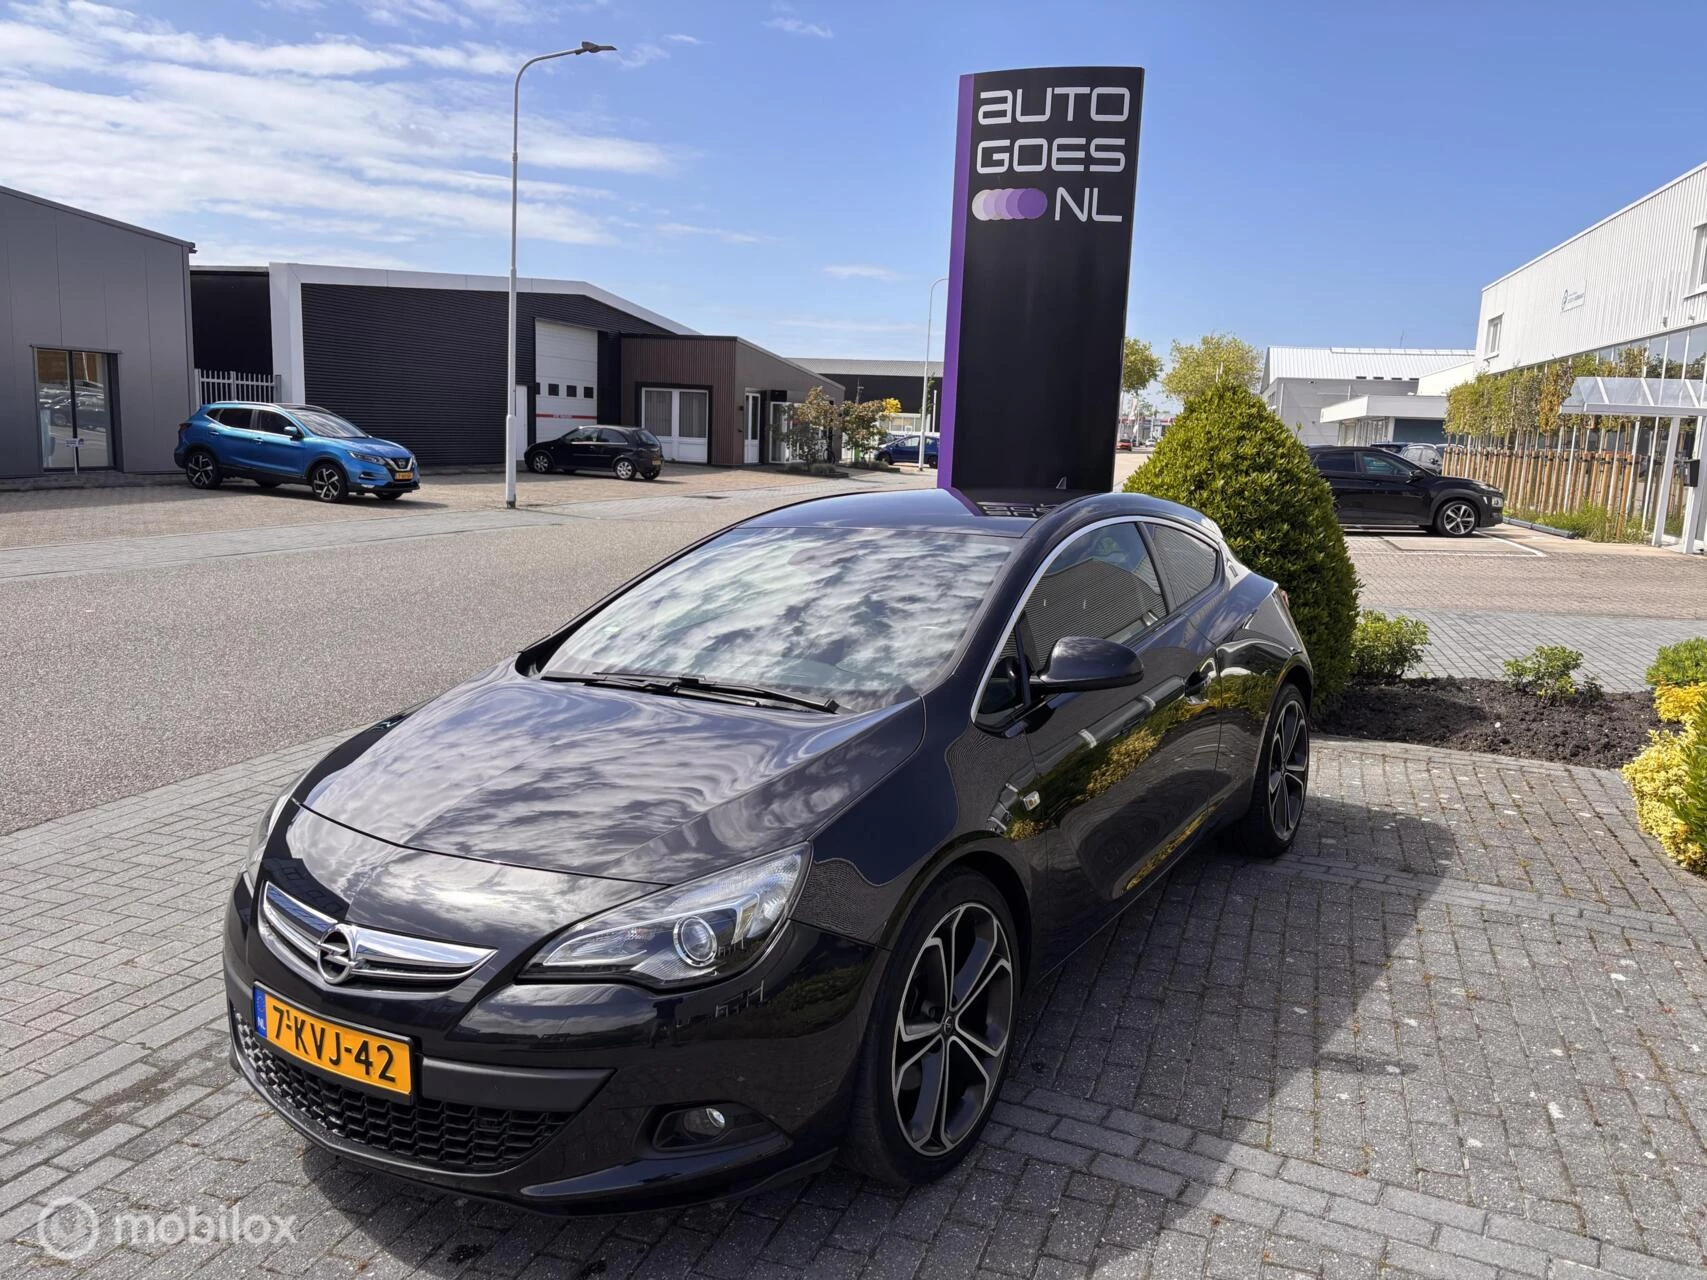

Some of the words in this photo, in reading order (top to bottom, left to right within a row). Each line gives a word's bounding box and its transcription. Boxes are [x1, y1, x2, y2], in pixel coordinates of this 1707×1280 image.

[976, 137, 1126, 174] GOES
[1054, 186, 1123, 222] NL
[273, 1005, 396, 1083] 7-KVJ-42
